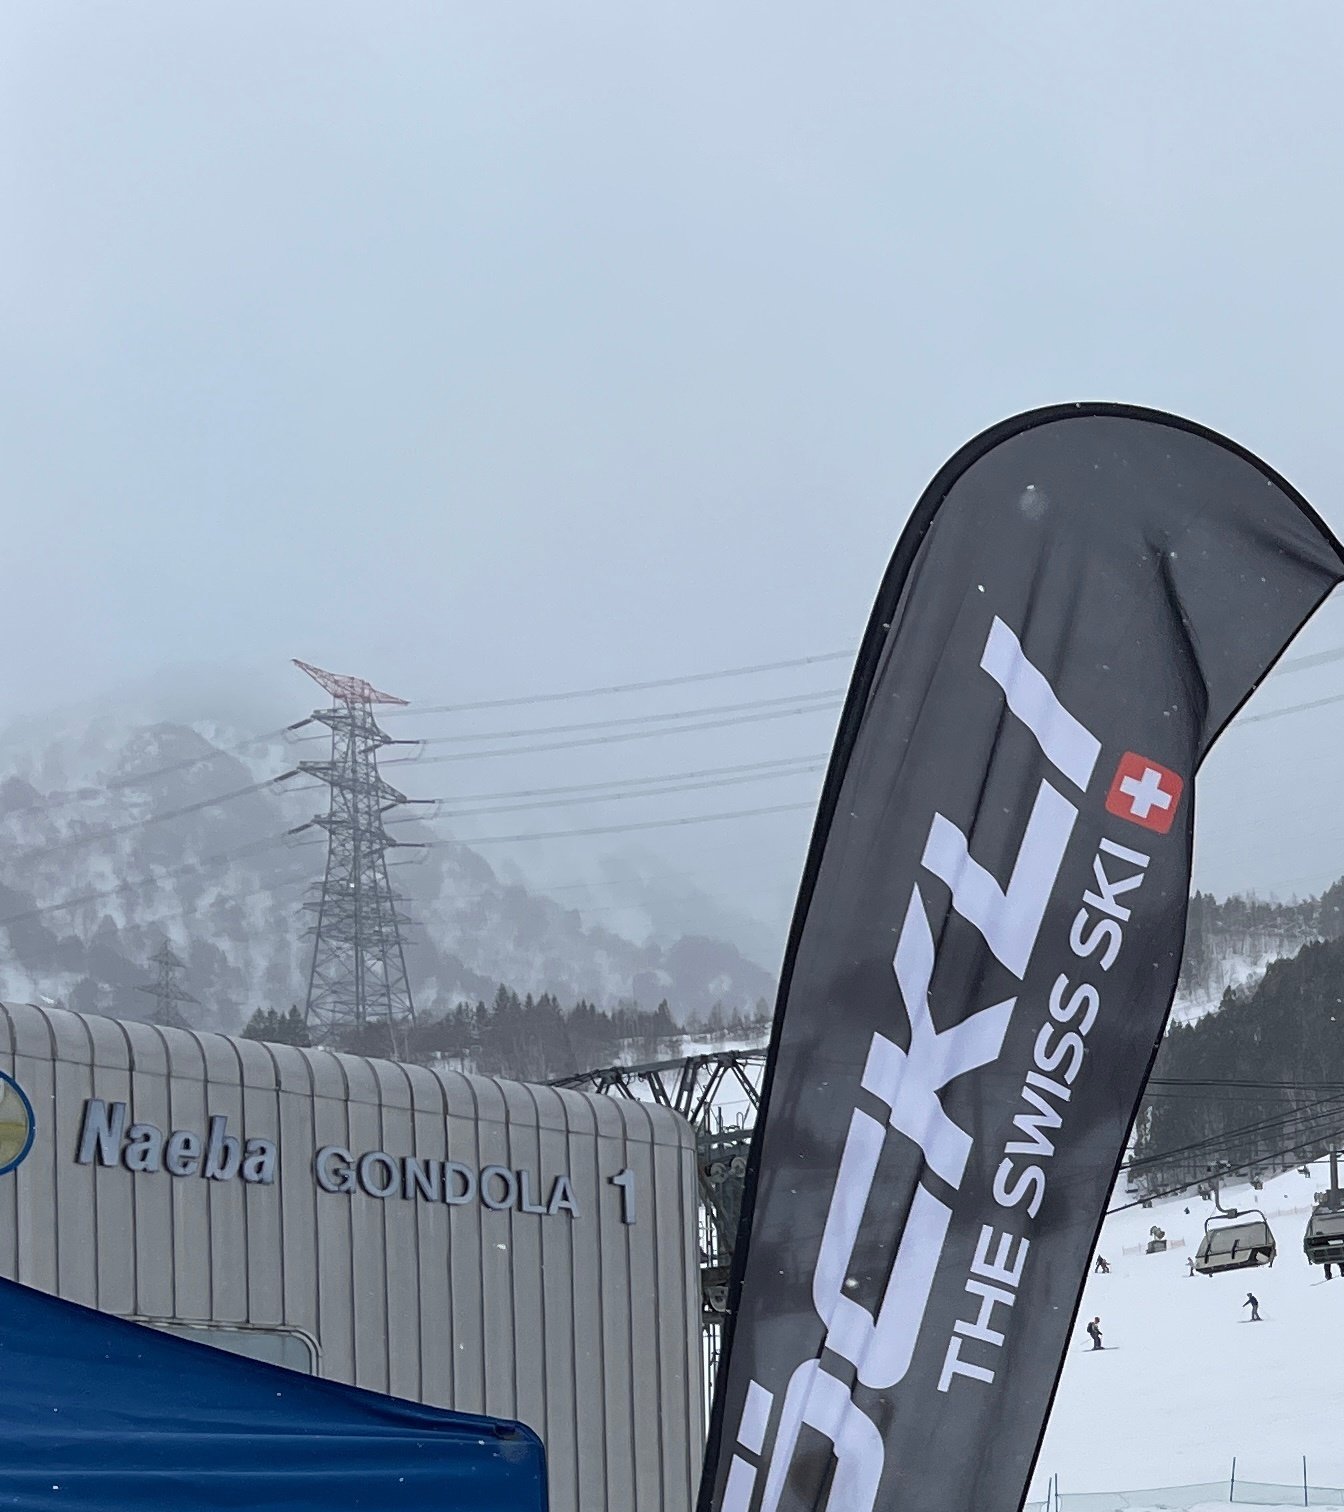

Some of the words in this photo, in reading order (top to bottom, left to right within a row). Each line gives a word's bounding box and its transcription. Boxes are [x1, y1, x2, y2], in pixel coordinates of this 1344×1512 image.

[74, 1098, 277, 1187] Naeba
[314, 1145, 581, 1219] GONDOLA
[609, 1168, 638, 1224] 1
[937, 1225, 1030, 1392] THE
[993, 973, 1100, 1219] SWISS
[1070, 838, 1151, 971] SKI
